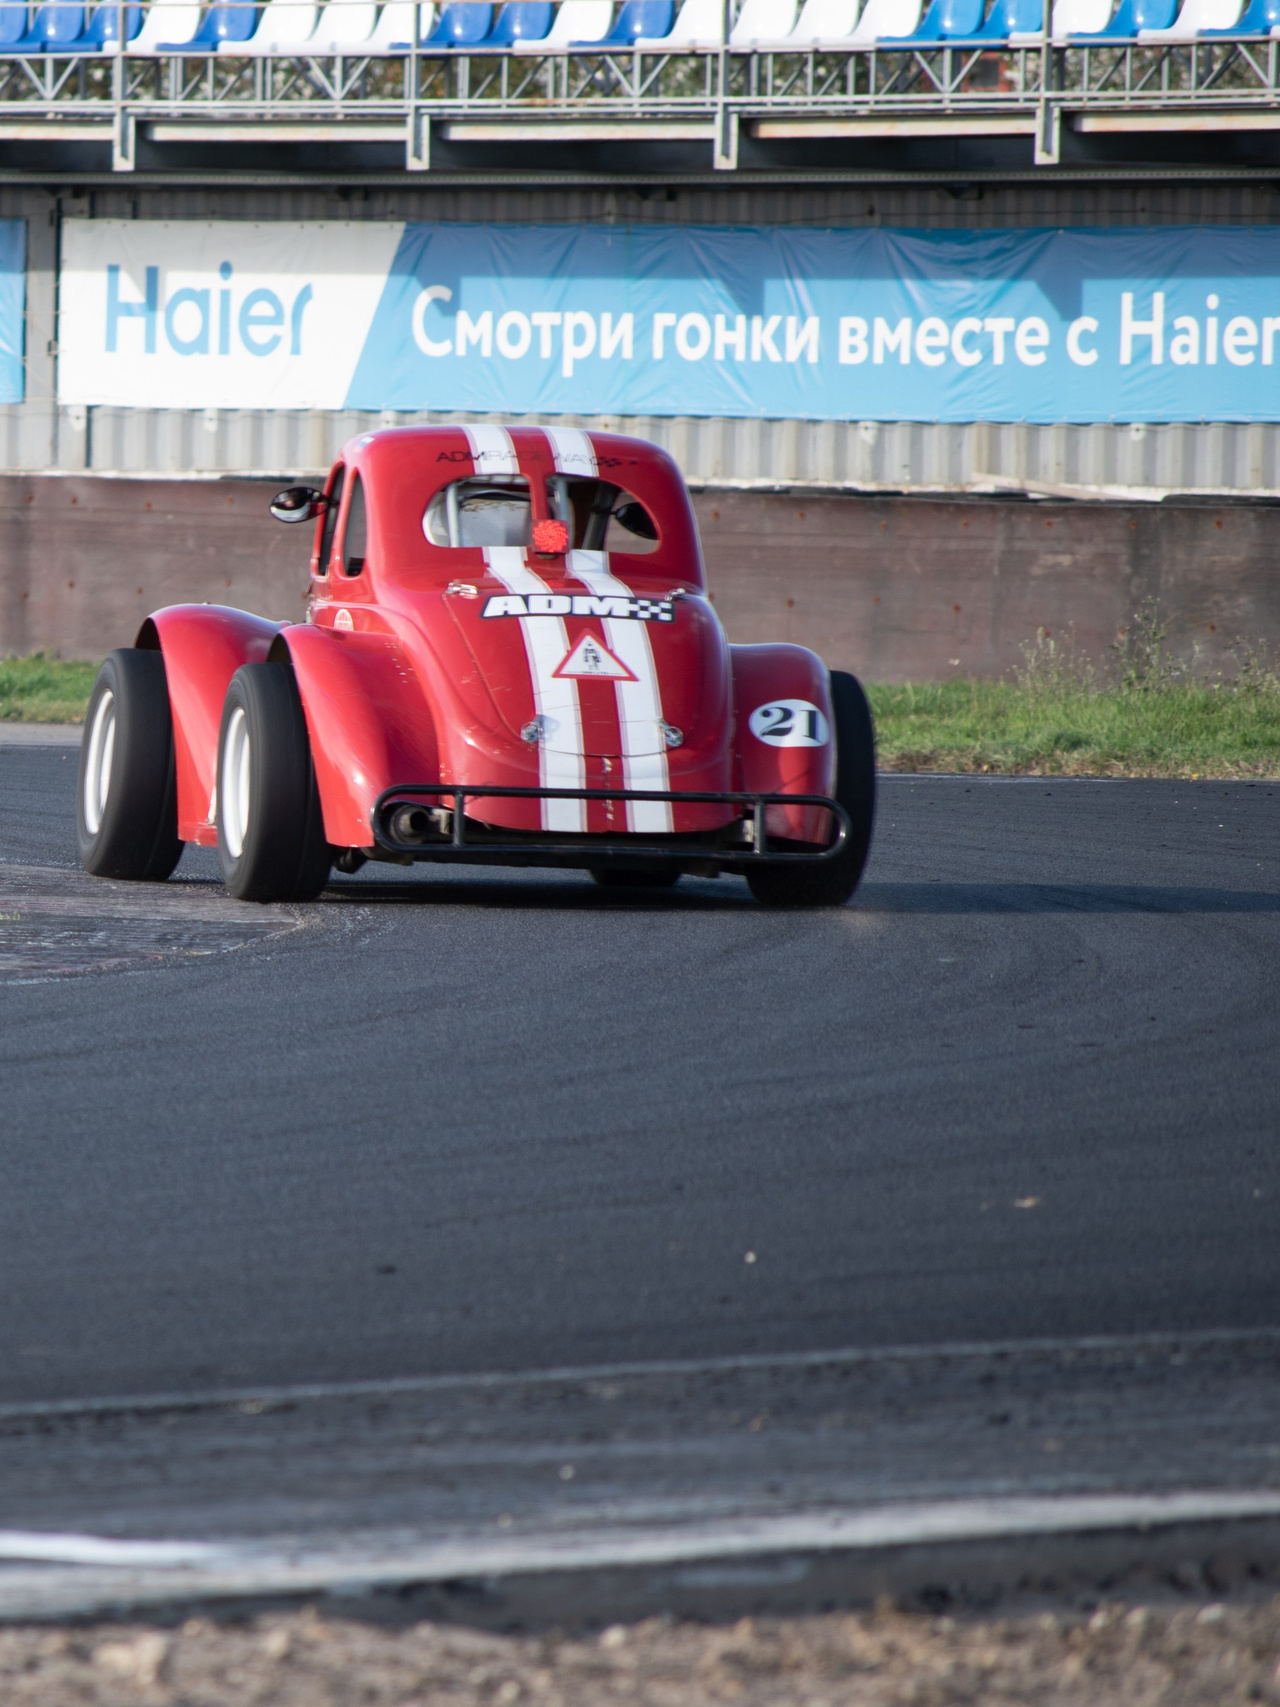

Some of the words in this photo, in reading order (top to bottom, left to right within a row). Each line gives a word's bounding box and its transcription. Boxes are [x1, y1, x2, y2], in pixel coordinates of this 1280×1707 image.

[105, 260, 314, 357] Haier
[412, 286, 635, 378] Смотри
[652, 313, 820, 364] гонки
[838, 316, 1050, 367] вместе
[1066, 316, 1099, 366] с
[1119, 291, 1280, 366] Haier
[482, 595, 631, 617] ADM
[760, 706, 823, 743] 21
